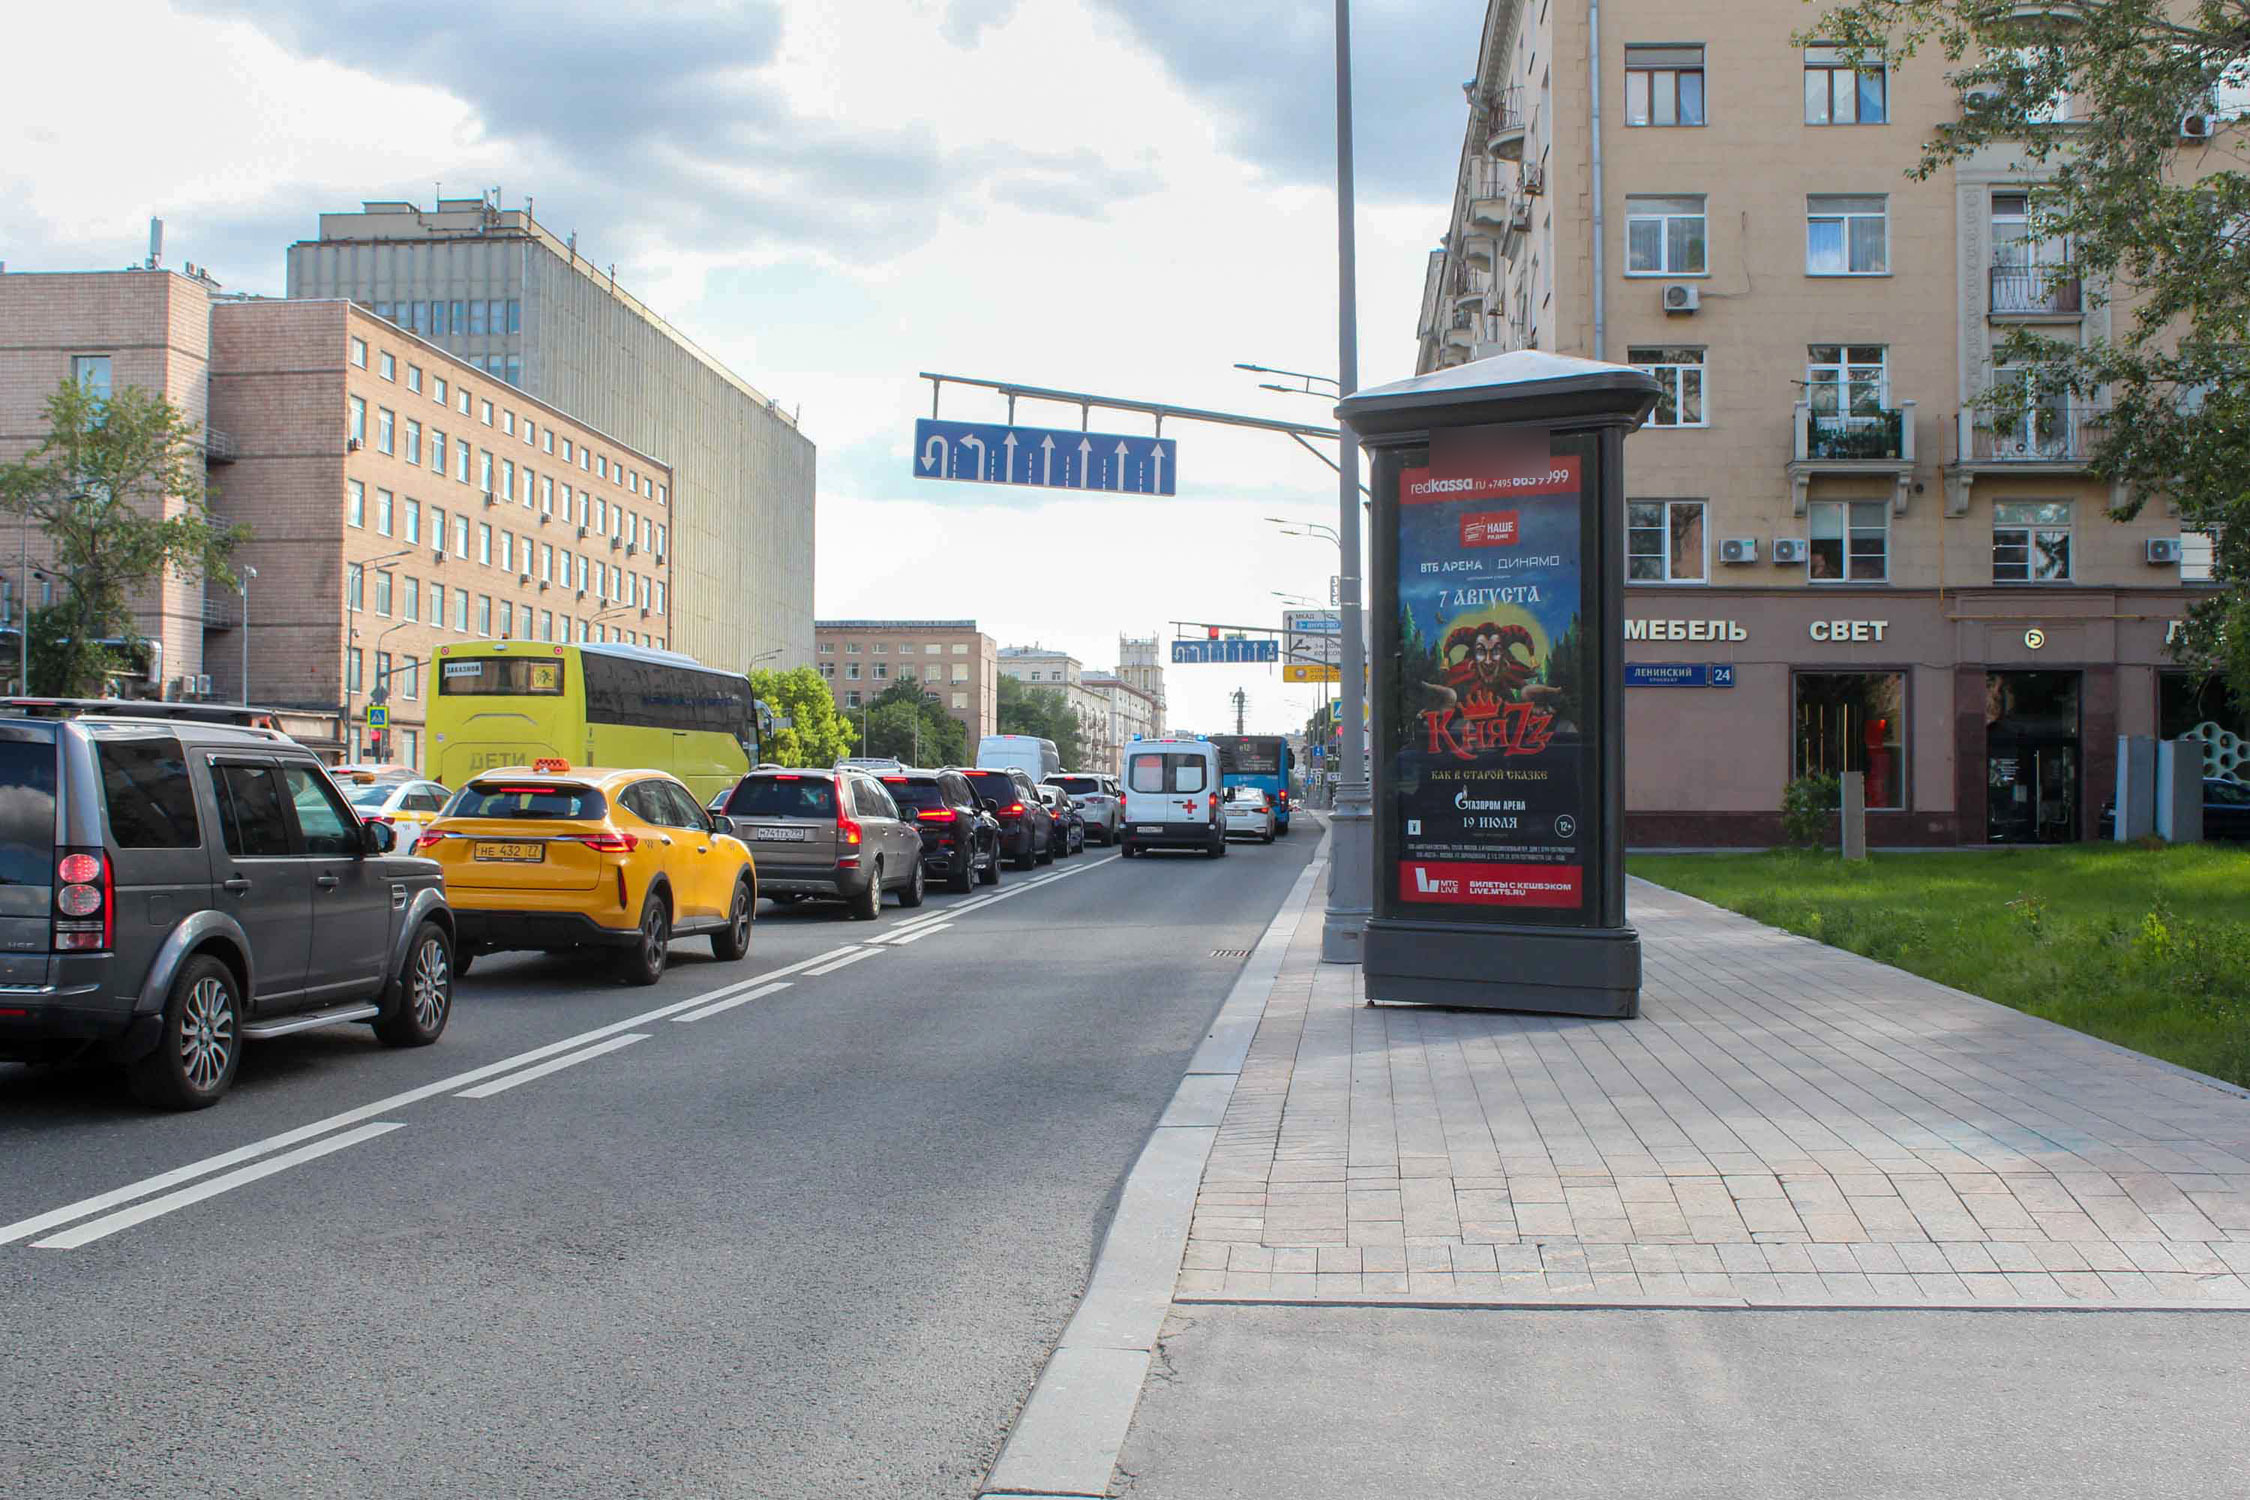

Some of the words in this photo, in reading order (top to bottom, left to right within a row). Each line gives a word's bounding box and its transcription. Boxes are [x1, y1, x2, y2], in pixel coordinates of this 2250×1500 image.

[1410, 477, 1486, 495] redkassa.ru
[1488, 479, 1512, 490] +7495
[1487, 521, 1514, 533] НАШЕ
[1420, 562, 1439, 574] ВТБ
[1441, 559, 1483, 573] АРЕНА
[1497, 555, 1561, 569] ДИНАМО
[1439, 590, 1448, 608] 7
[1453, 585, 1541, 609] АВГУСТА
[1624, 619, 1748, 641] МЕБЕЛЬ
[1809, 619, 1889, 642] СВЕТ
[1634, 667, 1692, 677] ЛЕНИНСКИЙ
[1714, 669, 1731, 681] 24
[469, 752, 527, 772] ДЕТИ
[1431, 770, 1452, 780] КАК
[1454, 770, 1461, 780] В
[1463, 769, 1505, 780] СТАРОЙ
[1506, 770, 1549, 781] СКАЗКЕ
[1468, 800, 1501, 811] ГАЗПРОМ
[1503, 800, 1526, 811] АРЕНА
[1463, 816, 1475, 828] 19
[1479, 816, 1518, 829] ИЮЛЯ
[1560, 821, 1573, 832] 12+
[499, 844, 521, 857] 432
[1440, 886, 1459, 894] LIVE
[1469, 880, 1509, 888] БИЛЕТЫ
[1509, 881, 1516, 889] С
[1517, 882, 1573, 891] КЕШБЭКОМ
[1469, 888, 1526, 896] LIVE.MTS.RU
